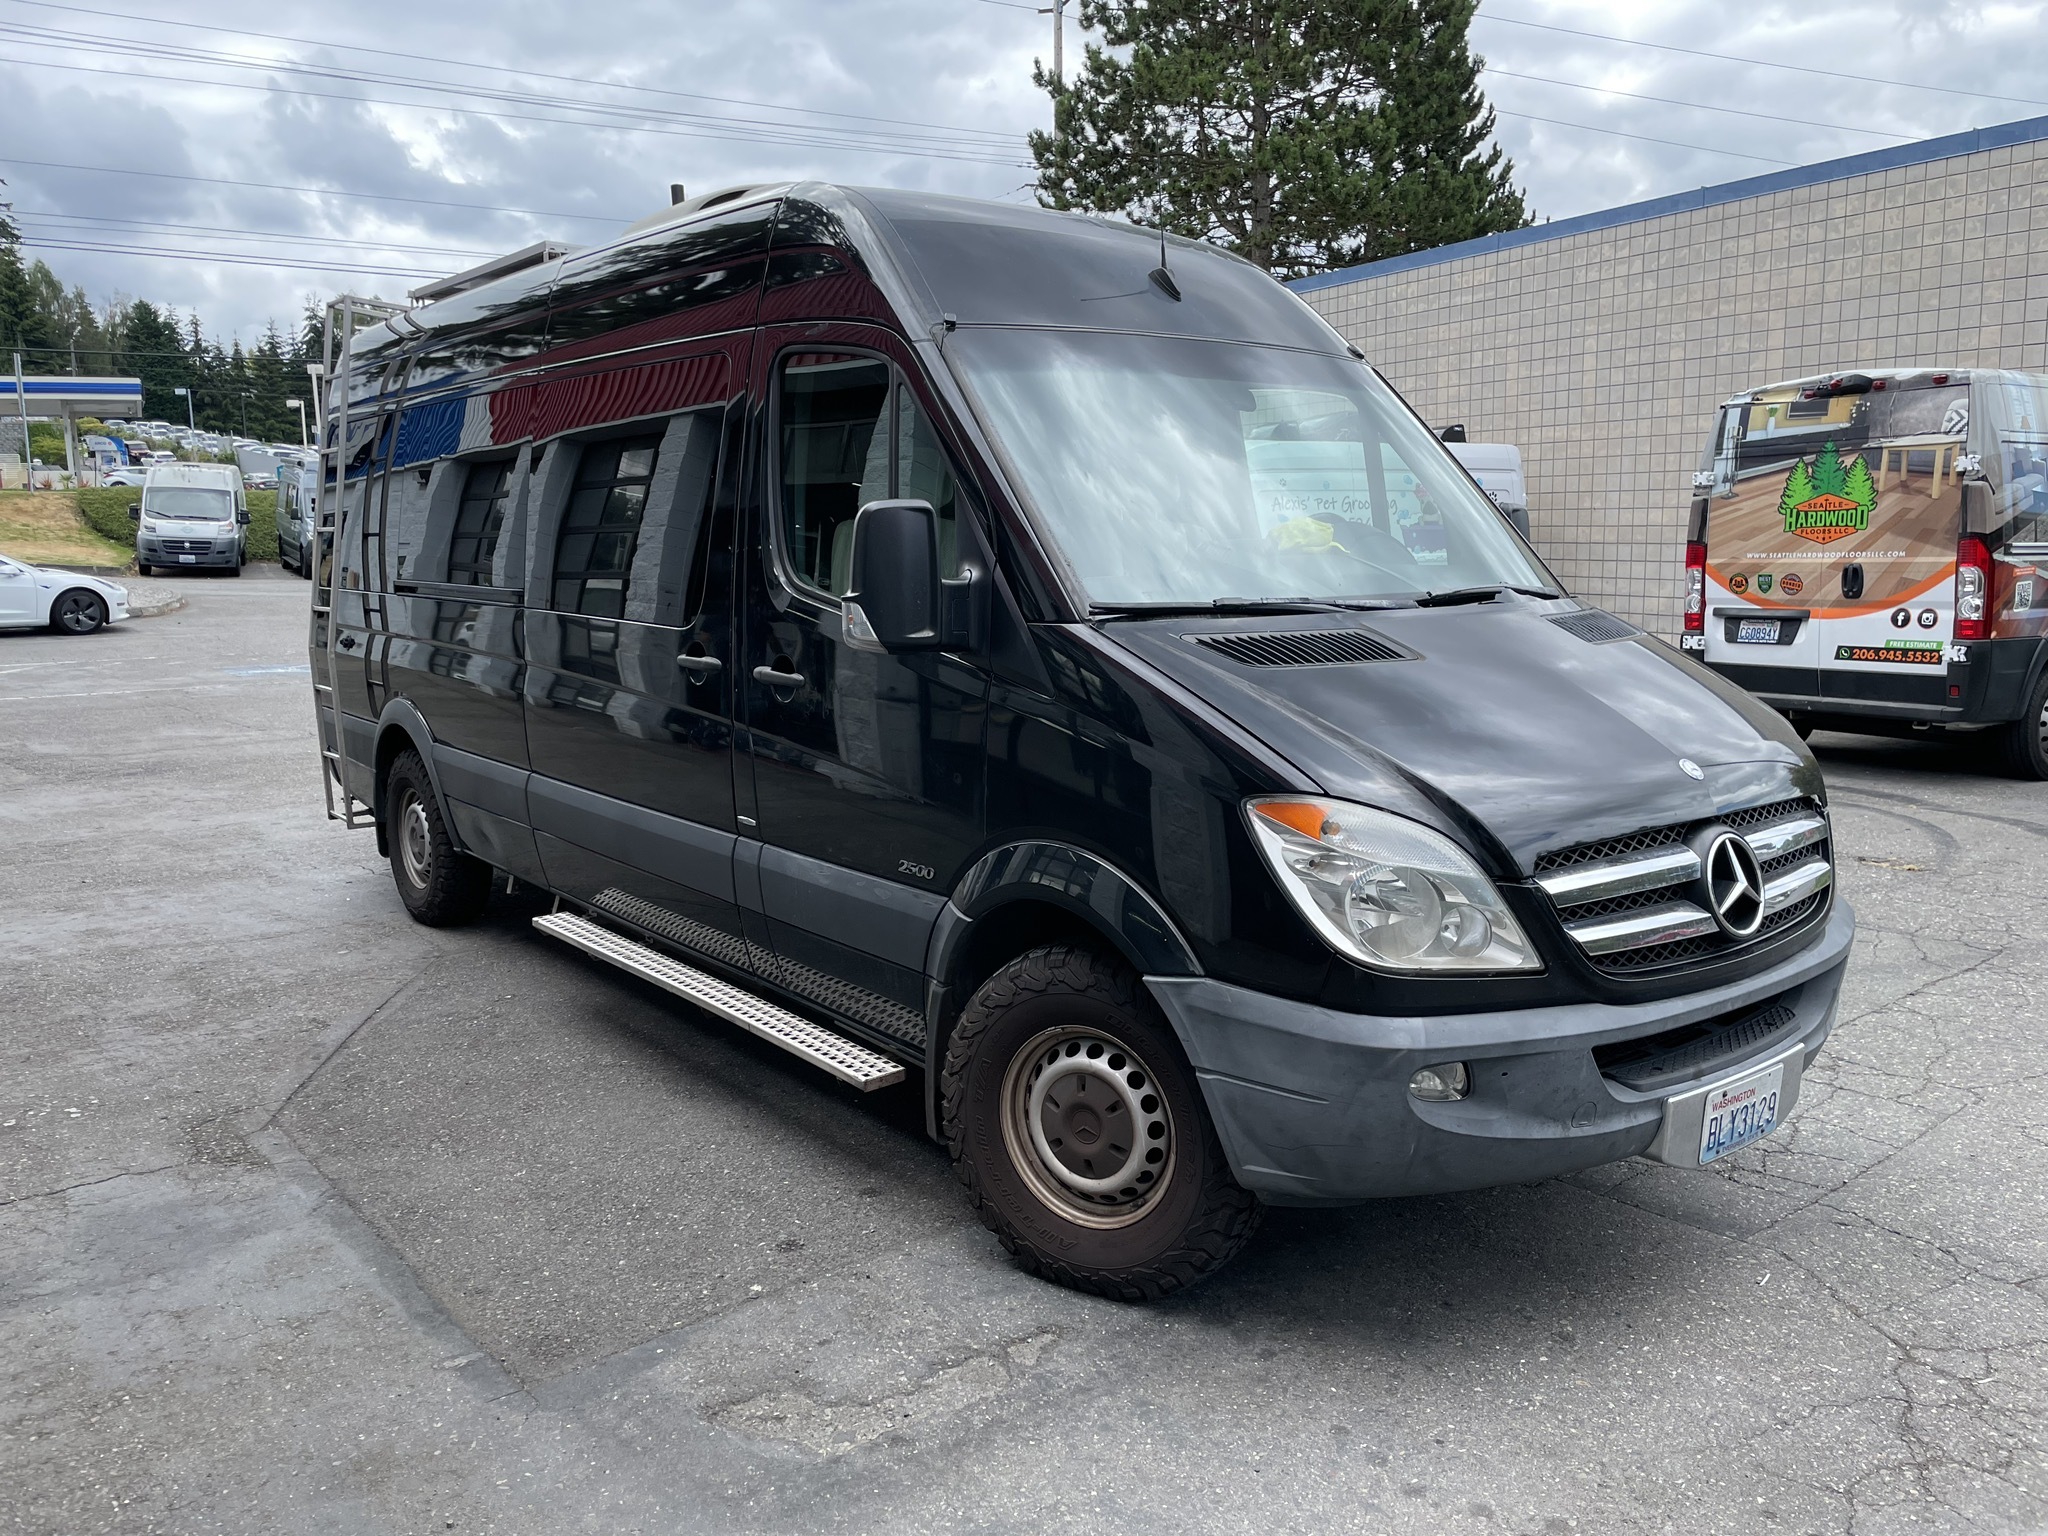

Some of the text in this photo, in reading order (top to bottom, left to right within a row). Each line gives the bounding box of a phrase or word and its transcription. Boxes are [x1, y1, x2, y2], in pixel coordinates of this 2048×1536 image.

[1271, 496, 1399, 515] Alexis' Pet Groog
[1808, 500, 1844, 510] SEATTLE
[1784, 505, 1869, 533] HARDWOOD
[1746, 551, 1906, 559] WWW.SEATTLEHARDWOODFLOORSLLC.COM
[1739, 627, 1777, 639] C60894Y
[1906, 641, 1938, 649] ESTIMATE
[1852, 648, 1938, 662] 206.945.5532
[898, 859, 935, 880] 2500
[1712, 1088, 1756, 1112] WASHINGTON
[1706, 1091, 1776, 1153] BLY3129
[976, 1114, 1080, 1251] All-Terrain
